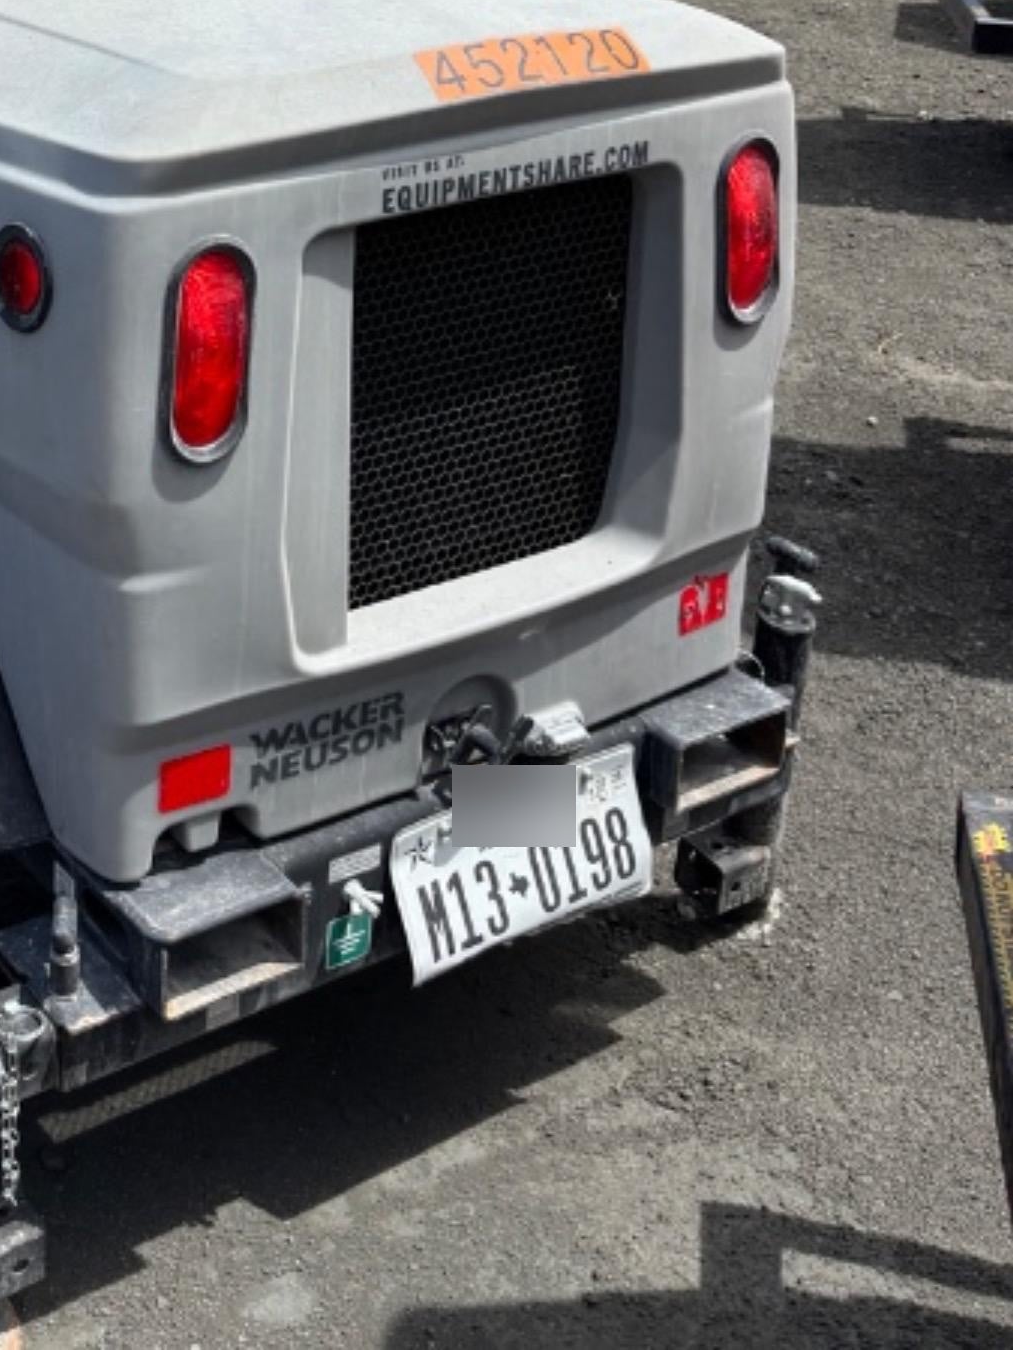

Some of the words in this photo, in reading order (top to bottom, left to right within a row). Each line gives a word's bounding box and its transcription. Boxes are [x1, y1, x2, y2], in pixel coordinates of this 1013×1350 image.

[434, 28, 640, 91] 452120
[381, 140, 650, 214] EQUIPMENTSHARE.COM
[249, 691, 405, 755] WACKER
[249, 716, 405, 790] NEUSON
